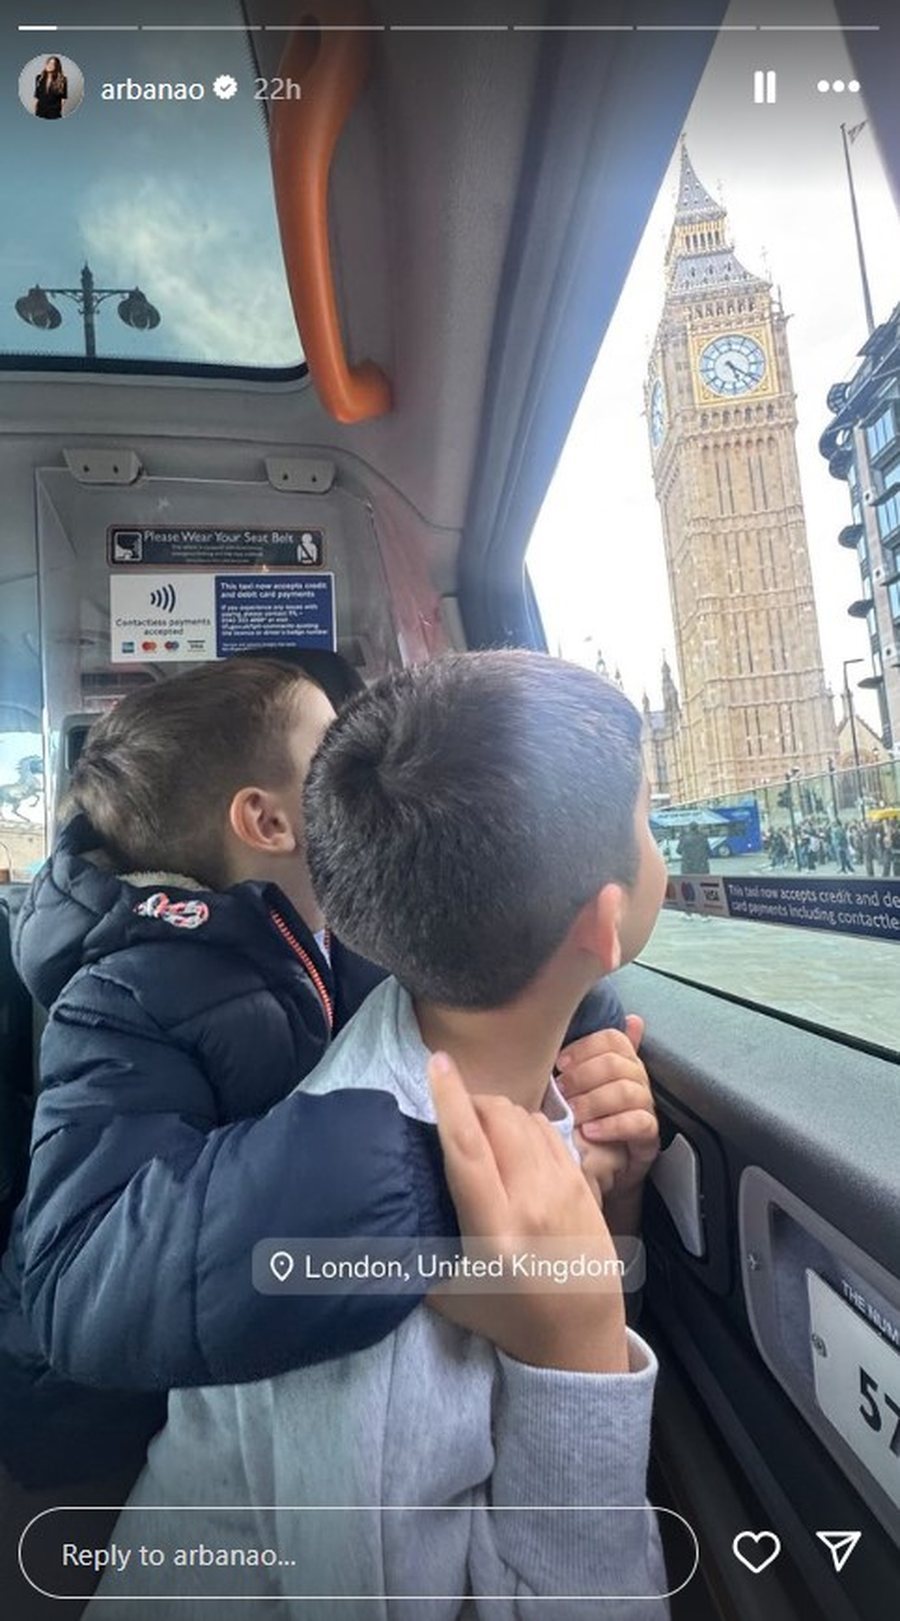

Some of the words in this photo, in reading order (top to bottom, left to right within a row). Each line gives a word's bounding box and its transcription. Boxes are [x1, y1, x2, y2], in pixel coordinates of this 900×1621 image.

[144, 530, 181, 543] Please
[181, 532, 212, 543] Wear
[214, 532, 241, 543] Your
[244, 533, 268, 544] Seat
[272, 532, 294, 544] Belt
[221, 582, 237, 590] This
[273, 583, 302, 591] accepts
[277, 591, 315, 599] payments
[116, 618, 167, 628] Contactless
[169, 618, 211, 628] payments
[144, 628, 184, 637] accepted
[728, 884, 743, 896] This
[744, 886, 759, 897] taxi
[760, 888, 778, 898] now
[780, 888, 817, 904] accepts
[819, 891, 852, 905] credit
[856, 891, 880, 907] and
[732, 901, 748, 912] card
[749, 902, 789, 918] payments
[790, 907, 835, 925] including
[837, 913, 900, 931] contactle
[842, 1280, 866, 1314] THE
